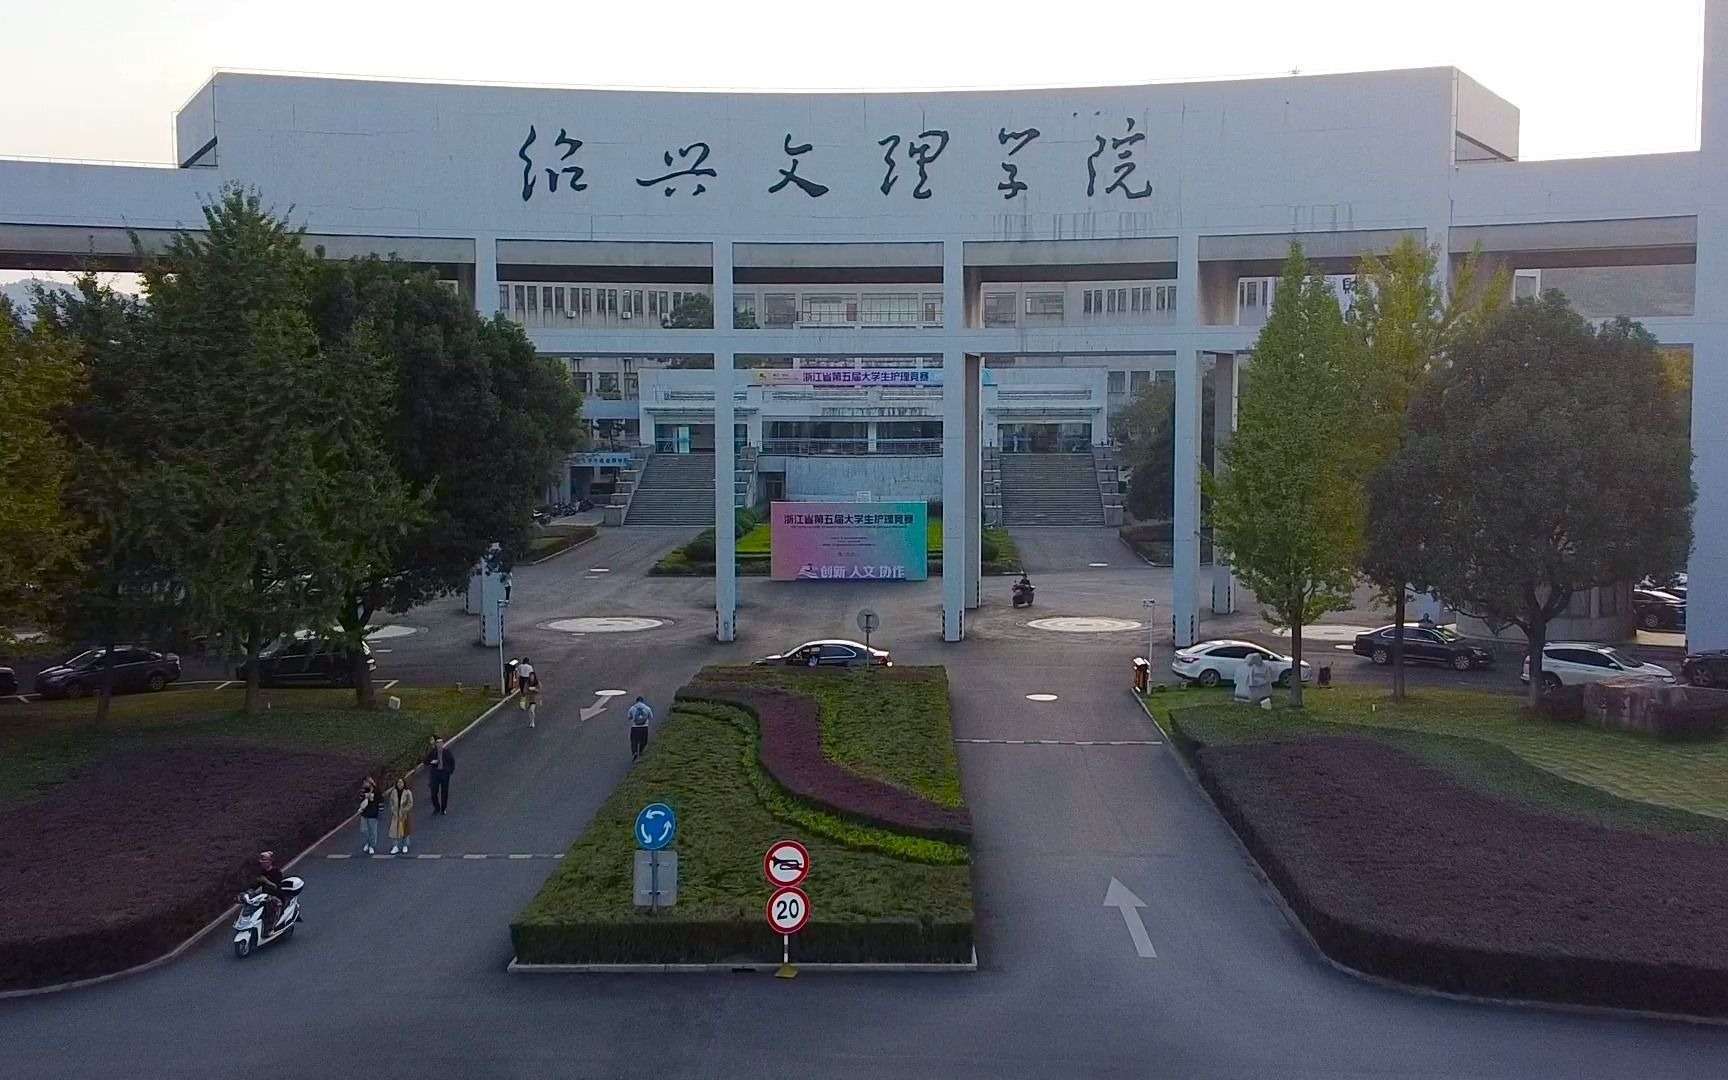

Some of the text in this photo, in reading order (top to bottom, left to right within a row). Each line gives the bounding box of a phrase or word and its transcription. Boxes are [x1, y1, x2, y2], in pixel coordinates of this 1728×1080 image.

[518, 117, 1153, 202] 绍兴文理学院
[802, 370, 930, 383] 浙江省第五届大学生护理竞赛
[784, 513, 914, 526] 浙江省第五届大学生护理竞赛
[820, 565, 847, 579] 创新
[850, 565, 877, 579] 人文
[776, 899, 800, 920] 20
